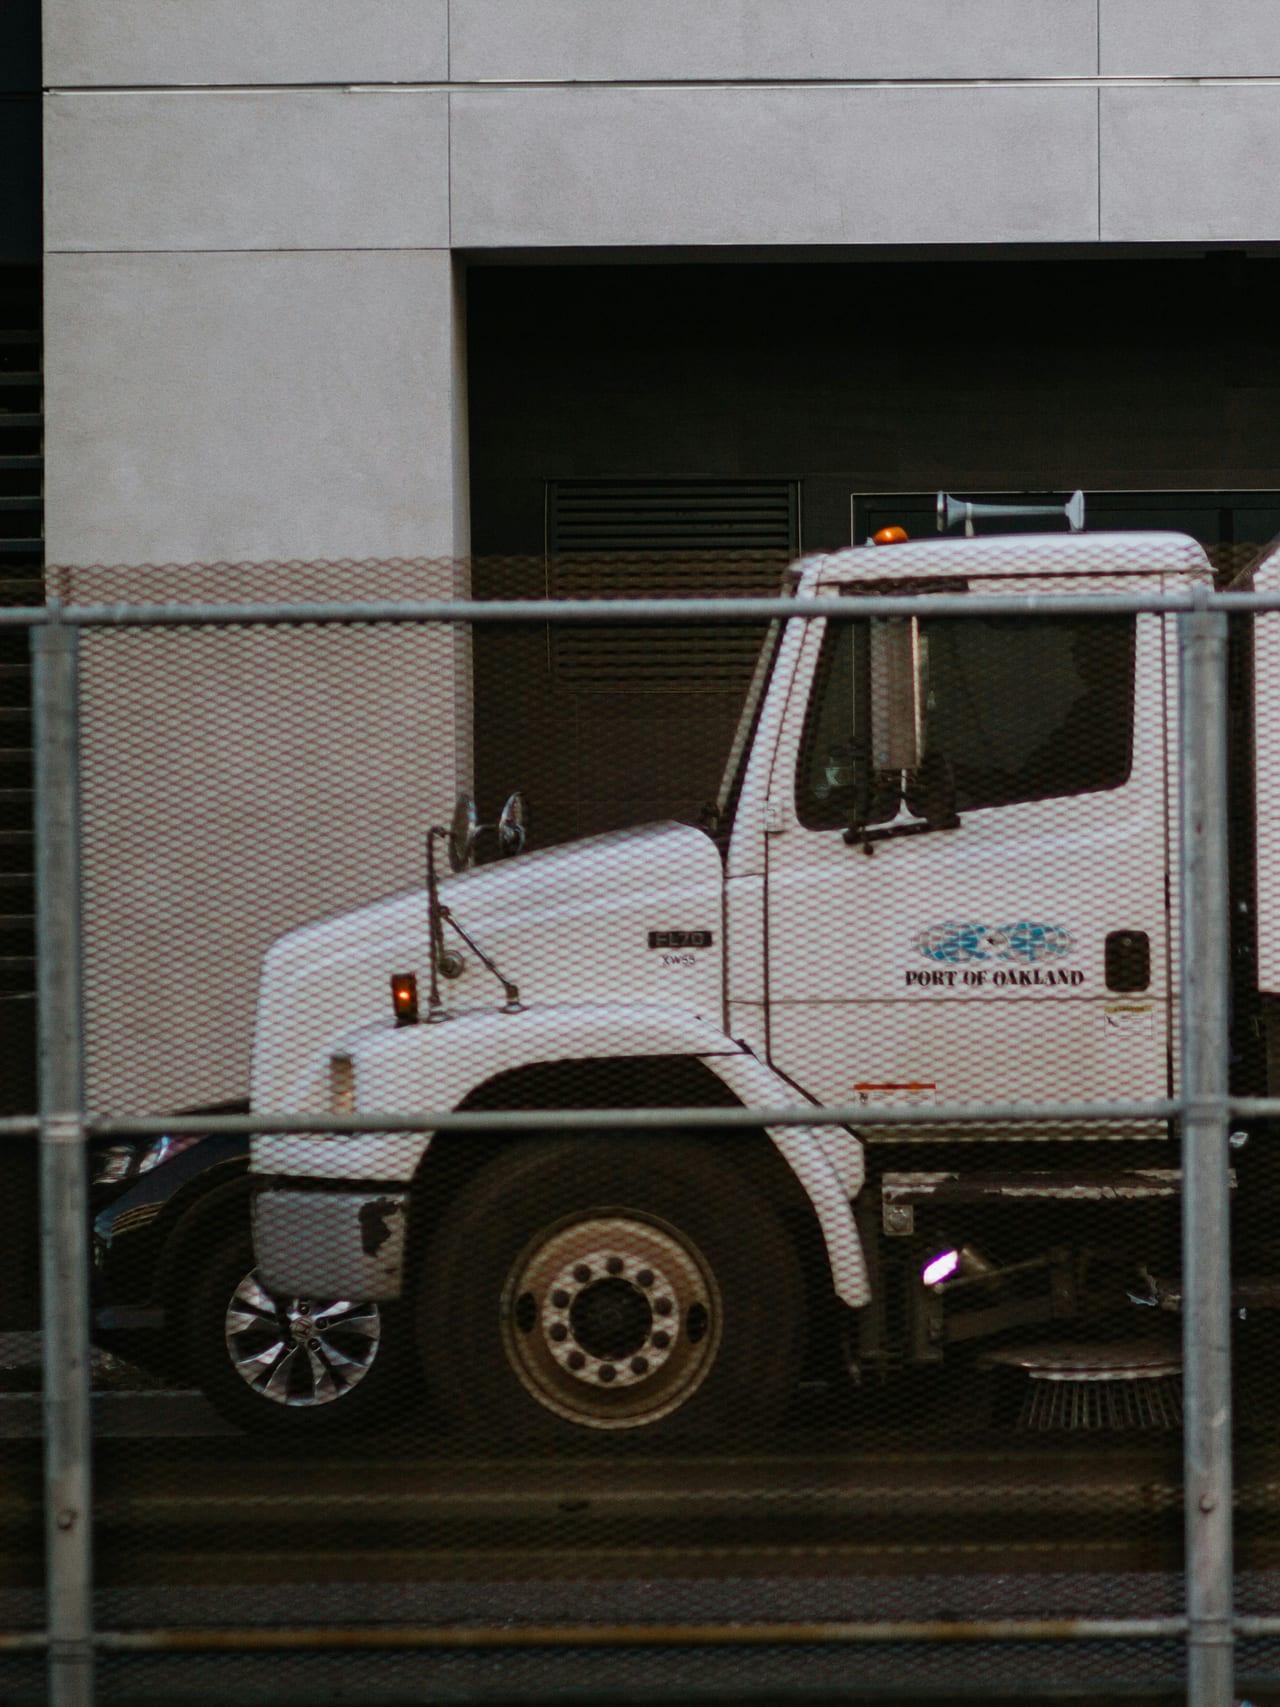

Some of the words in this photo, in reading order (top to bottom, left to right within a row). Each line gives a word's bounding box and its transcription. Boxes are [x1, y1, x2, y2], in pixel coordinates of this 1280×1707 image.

[905, 970, 957, 986] PORT
[963, 970, 988, 986] OF
[992, 970, 1085, 986] OAKLAND
